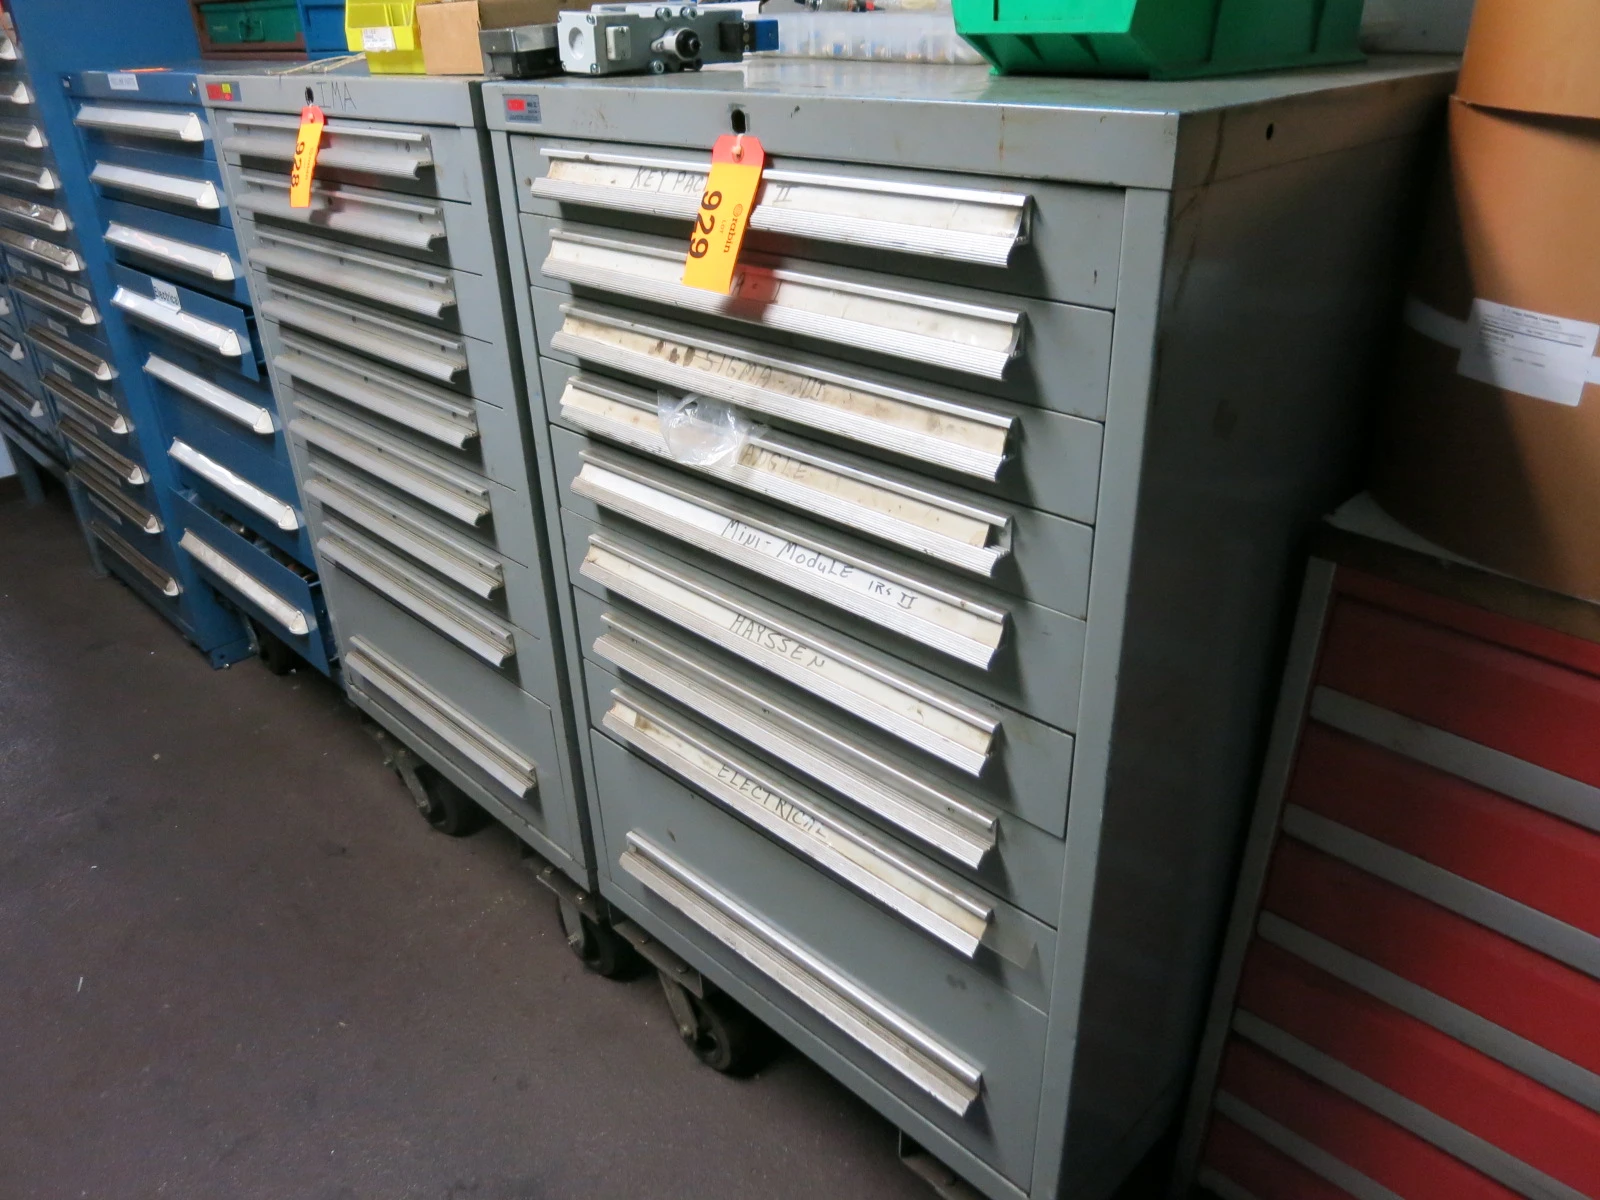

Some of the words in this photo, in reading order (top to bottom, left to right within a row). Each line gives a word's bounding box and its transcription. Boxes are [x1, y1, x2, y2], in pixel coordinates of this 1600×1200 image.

[316, 81, 357, 111] IMA
[291, 141, 306, 188] 928
[630, 166, 669, 192] KEY
[689, 190, 723, 259] 929
[723, 217, 738, 254] rabin
[698, 350, 773, 388] SIGMA
[717, 763, 828, 838] ELECTRICAL
